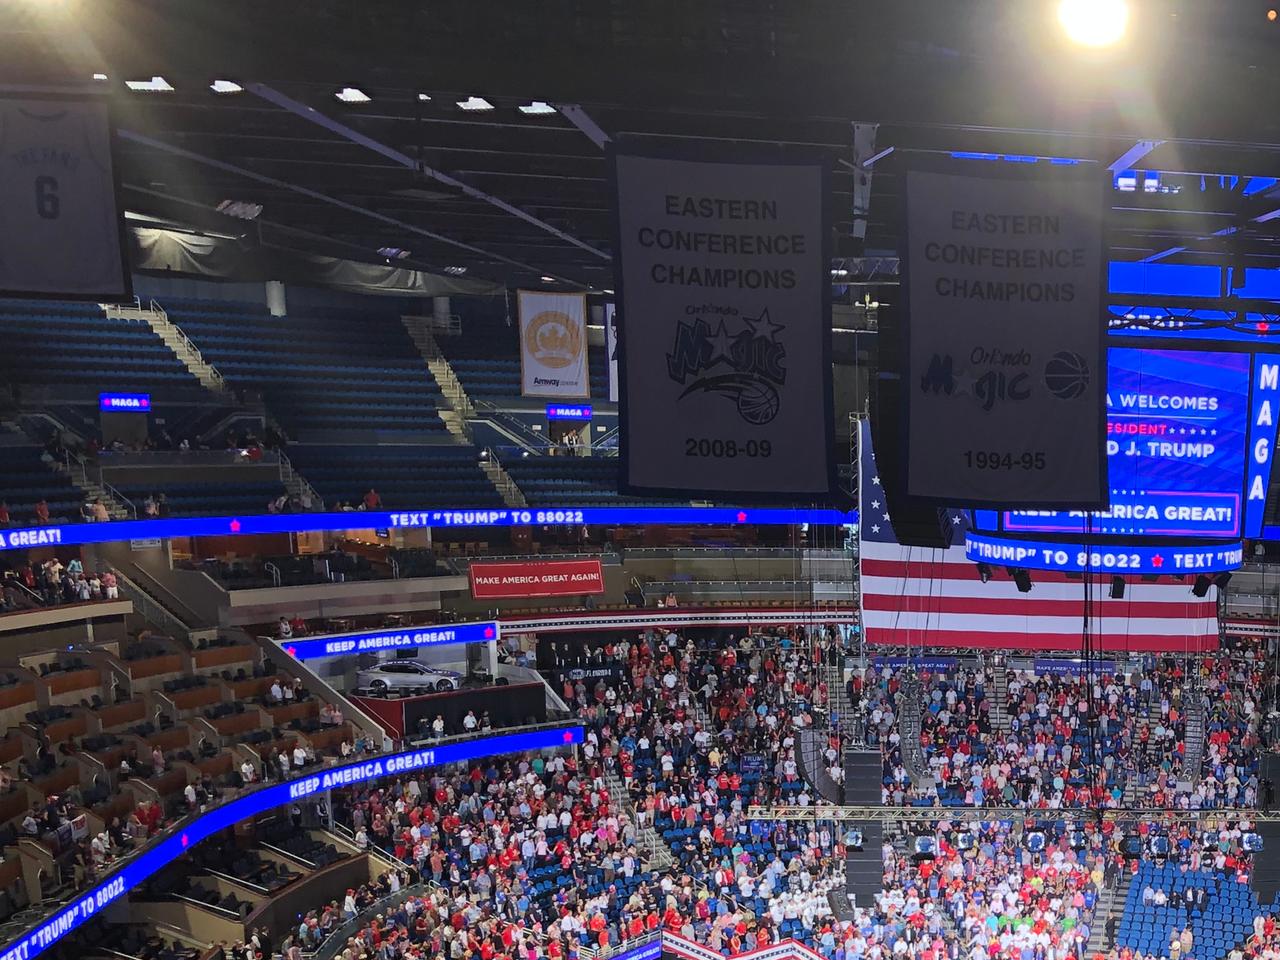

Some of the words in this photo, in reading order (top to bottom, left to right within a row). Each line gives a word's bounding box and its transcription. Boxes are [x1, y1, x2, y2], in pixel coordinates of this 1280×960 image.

[34, 174, 60, 220] 6
[665, 194, 778, 220] EASTERN
[951, 210, 1060, 235] EASTERN
[638, 227, 806, 255] CONFERENCE
[925, 242, 1087, 270] CONFERENCE
[651, 263, 796, 290] CHAMPIONS
[936, 276, 1076, 304] CHAMPIONS
[533, 376, 560, 388] Amway
[110, 398, 140, 407] MAGA
[556, 408, 583, 417] MAGA
[1119, 393, 1219, 411] WELCOMES
[685, 438, 772, 459] 2008-09
[1124, 440, 1141, 457] J.
[1147, 441, 1216, 459] TRUMP
[964, 450, 1047, 471] 1994-95
[390, 513, 429, 526] TEXT
[511, 511, 532, 524] TO
[536, 510, 584, 524] 88022
[1164, 506, 1232, 522] GREAT!
[9, 528, 62, 547] GREAT!
[1042, 549, 1069, 566] TO
[1076, 551, 1142, 568] 88022
[1173, 553, 1215, 568] TEXT
[475, 576, 501, 585] MAKE
[502, 575, 540, 584] AMERICA
[541, 574, 569, 583] GREAT
[570, 572, 600, 582] AGAIN!
[326, 640, 356, 654] KEEP
[357, 635, 413, 651] AMERICA
[414, 631, 457, 644] GREAT!
[290, 777, 321, 799] KEEP
[322, 760, 384, 790] AMERICA
[385, 750, 436, 773] GREAT!
[80, 894, 96, 919] TO
[96, 874, 126, 907] 88022
